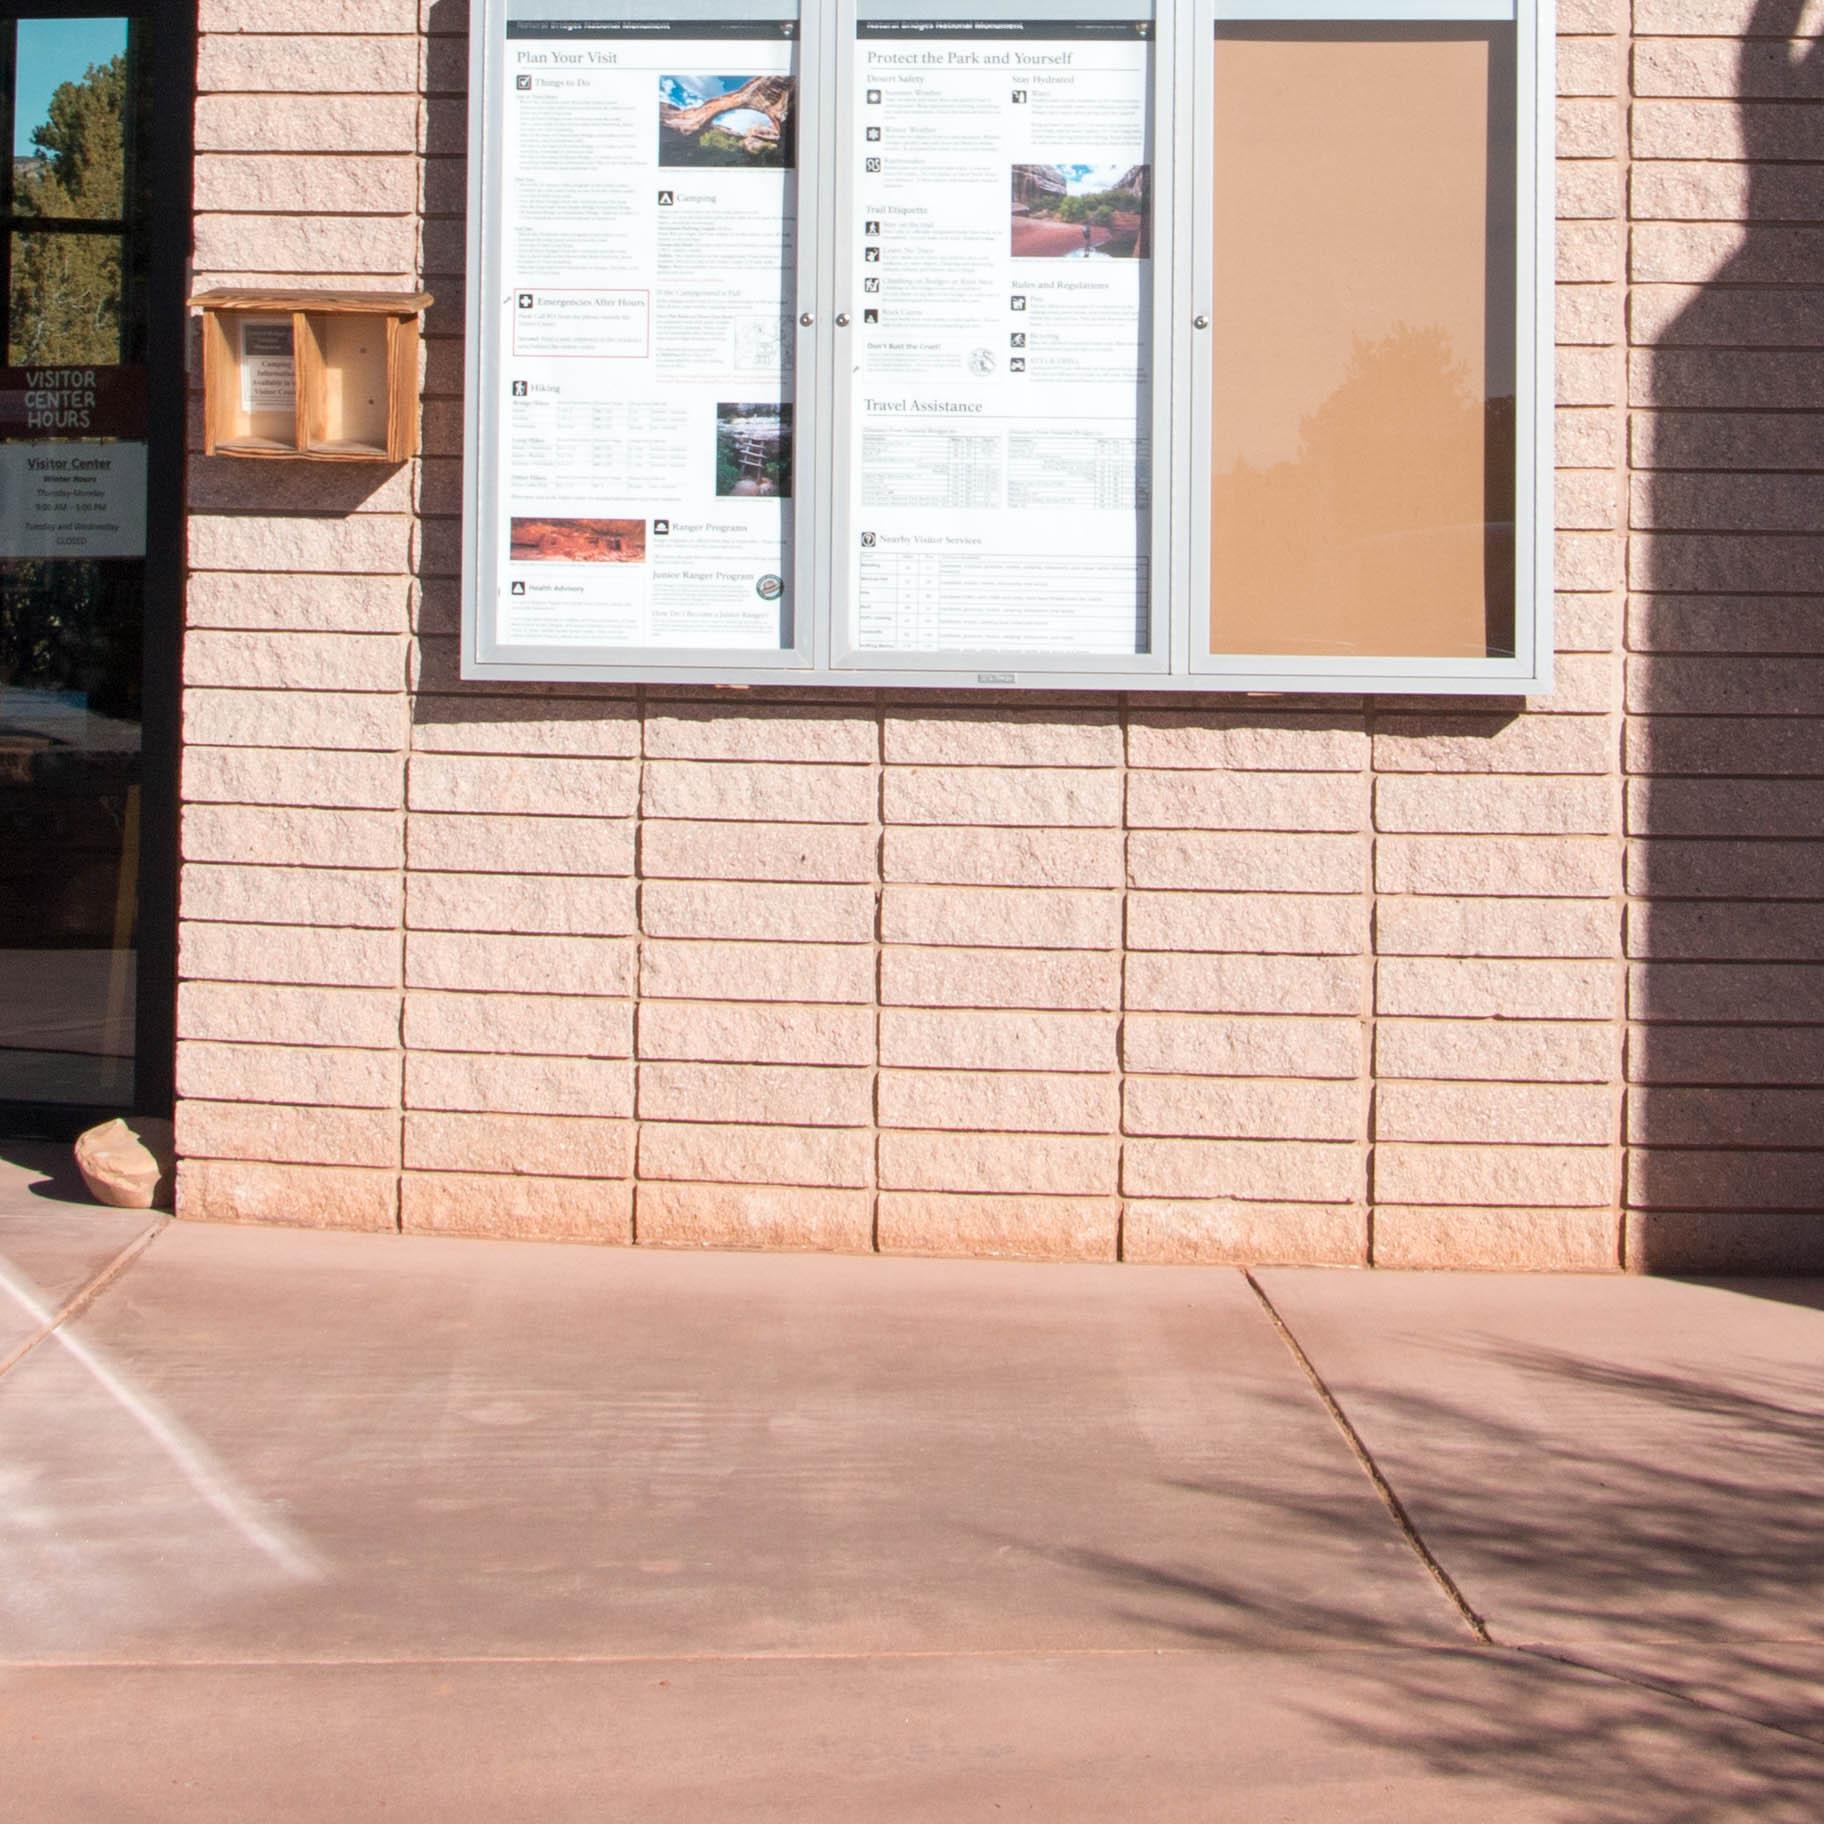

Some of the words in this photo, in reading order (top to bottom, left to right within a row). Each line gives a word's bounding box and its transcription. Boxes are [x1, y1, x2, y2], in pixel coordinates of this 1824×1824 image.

[517, 51, 547, 64] Plan
[551, 51, 583, 64] Your
[587, 51, 617, 64] Visit
[868, 52, 917, 64] Protect
[920, 52, 943, 64] the
[947, 52, 978, 64] Park
[984, 52, 1009, 65] and
[1015, 52, 1073, 65] Yourself
[535, 78, 565, 89] Things
[577, 79, 591, 88] Do
[676, 192, 717, 204] Camping
[1038, 280, 1055, 289] and
[537, 297, 592, 308] Emergencies
[594, 297, 615, 306] After
[618, 298, 646, 307] Hours
[26, 370, 96, 388] VISITOR
[25, 391, 96, 408] CENTER
[864, 398, 907, 412] Travel
[910, 399, 983, 413] Assistance
[28, 410, 91, 427] HOURS
[26, 458, 68, 470] Visitor
[71, 458, 112, 471] Center
[672, 522, 703, 533] Ranger
[705, 522, 748, 533] Programs
[880, 535, 911, 545] Nearby
[914, 536, 943, 544] Visitor
[945, 536, 982, 545] Services
[653, 571, 681, 580] Junior
[682, 571, 713, 581] Ranger
[715, 571, 755, 582] Program
